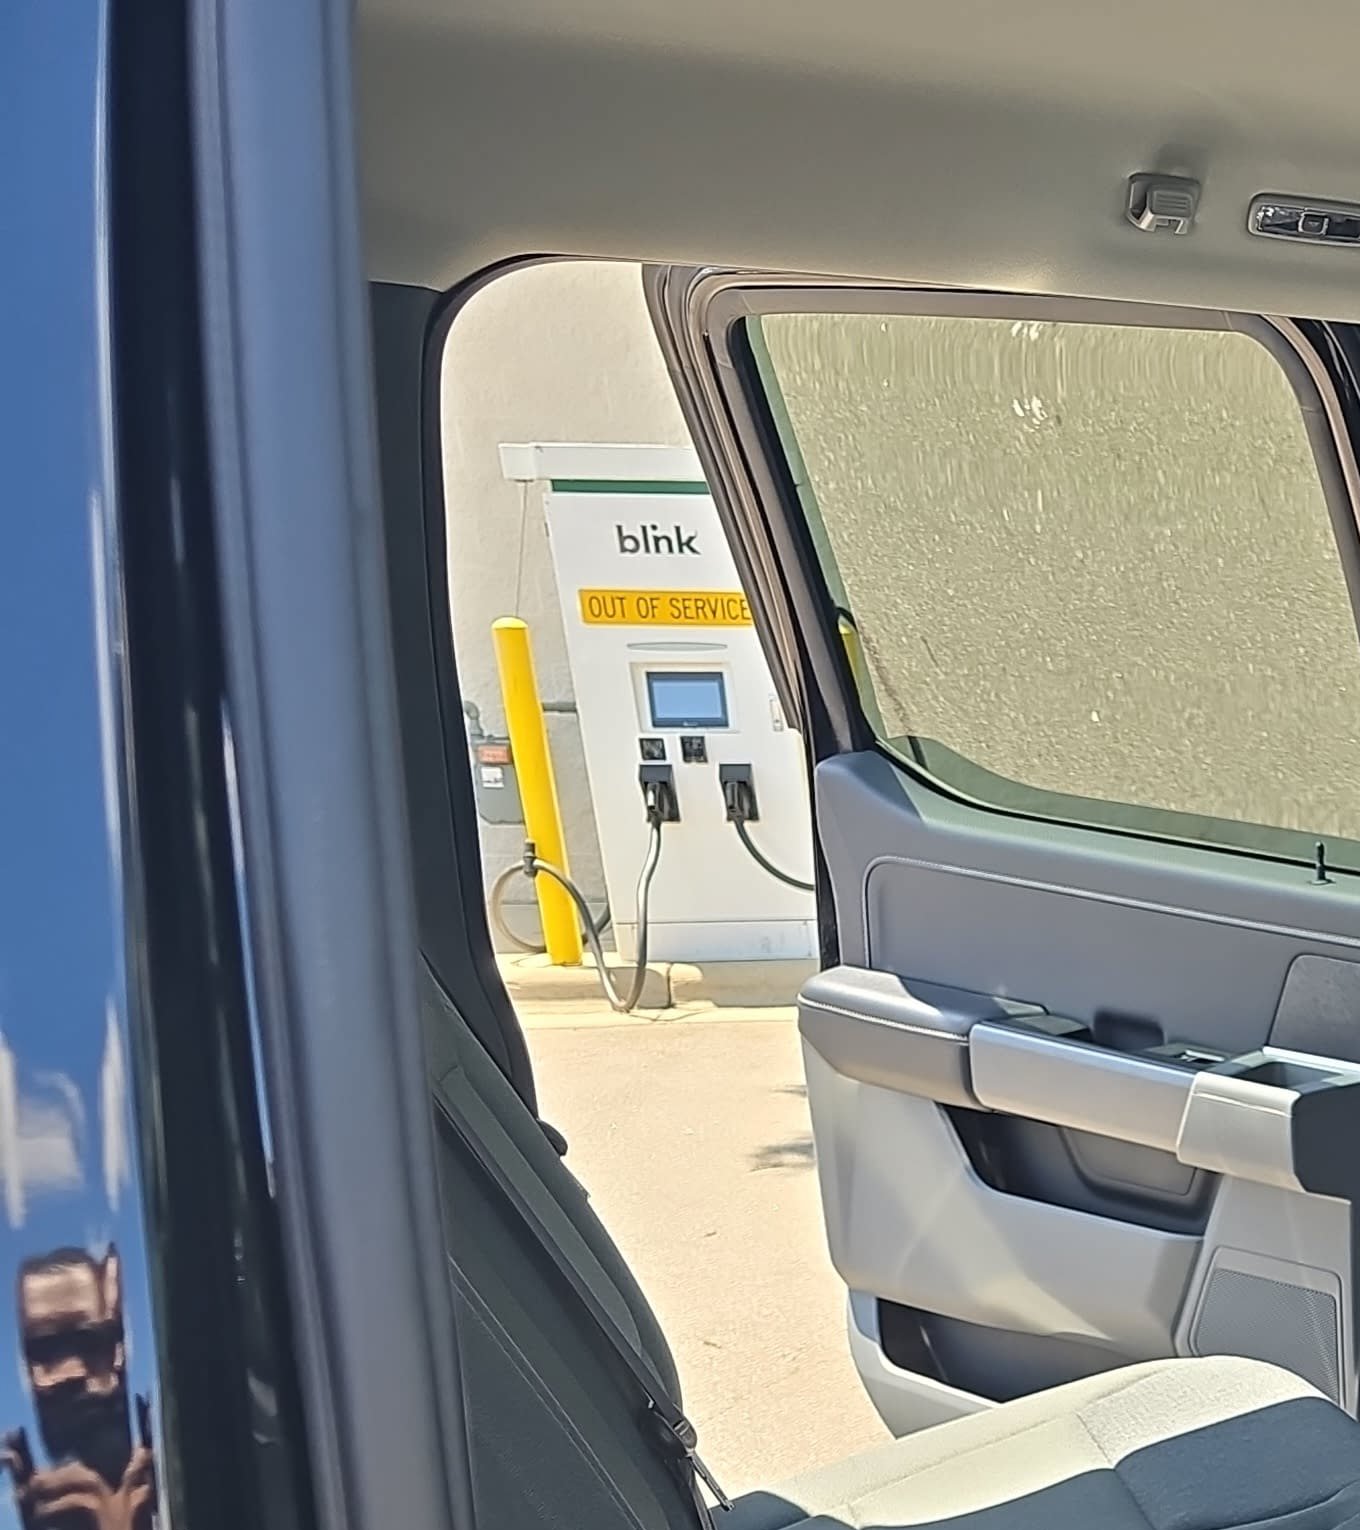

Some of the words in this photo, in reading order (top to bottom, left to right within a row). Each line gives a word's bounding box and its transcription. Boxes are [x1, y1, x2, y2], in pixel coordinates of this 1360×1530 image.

[615, 524, 702, 556] blink
[588, 595, 627, 619] OUT
[636, 596, 661, 619] OF
[670, 598, 752, 621] SERVICE
